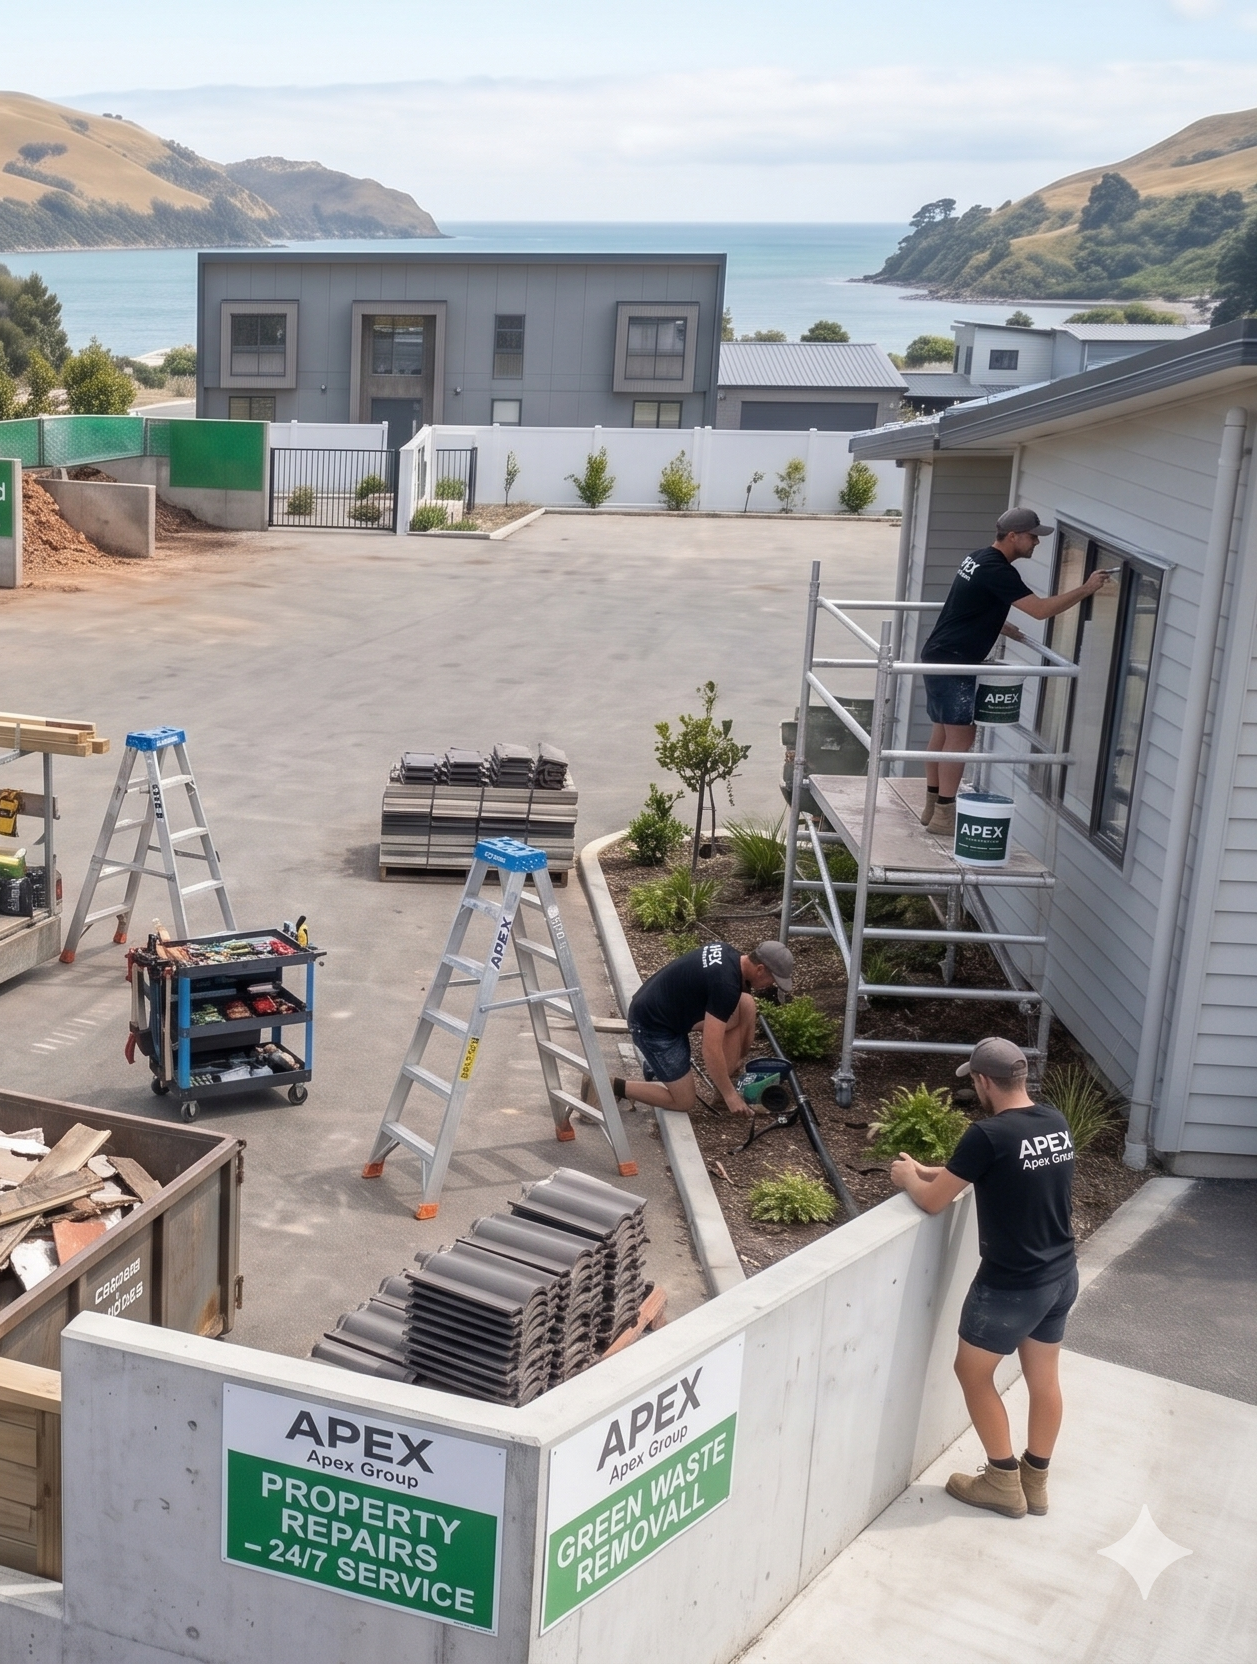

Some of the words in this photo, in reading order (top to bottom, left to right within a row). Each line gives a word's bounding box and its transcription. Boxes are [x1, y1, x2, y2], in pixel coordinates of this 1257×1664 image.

[984, 693, 1020, 704] APEX
[960, 822, 1004, 838] APEX
[490, 916, 513, 970] APEX
[1018, 1130, 1073, 1160] APEX
[1022, 1157, 1051, 1171] Apex
[285, 1409, 435, 1474] APEX
[596, 1365, 704, 1472] APEX
[306, 1448, 355, 1474] Apex
[360, 1462, 419, 1490] Group
[609, 1451, 645, 1486] Apex
[648, 1424, 688, 1460] Group
[261, 1470, 462, 1545] PROPERTY
[557, 1488, 643, 1570] GREEN
[650, 1431, 728, 1507] WASTE
[281, 1507, 439, 1573] REPAIRS
[576, 1481, 705, 1593] REMOVALL
[268, 1538, 328, 1573] 24/7
[336, 1556, 475, 1615] SERVICE
